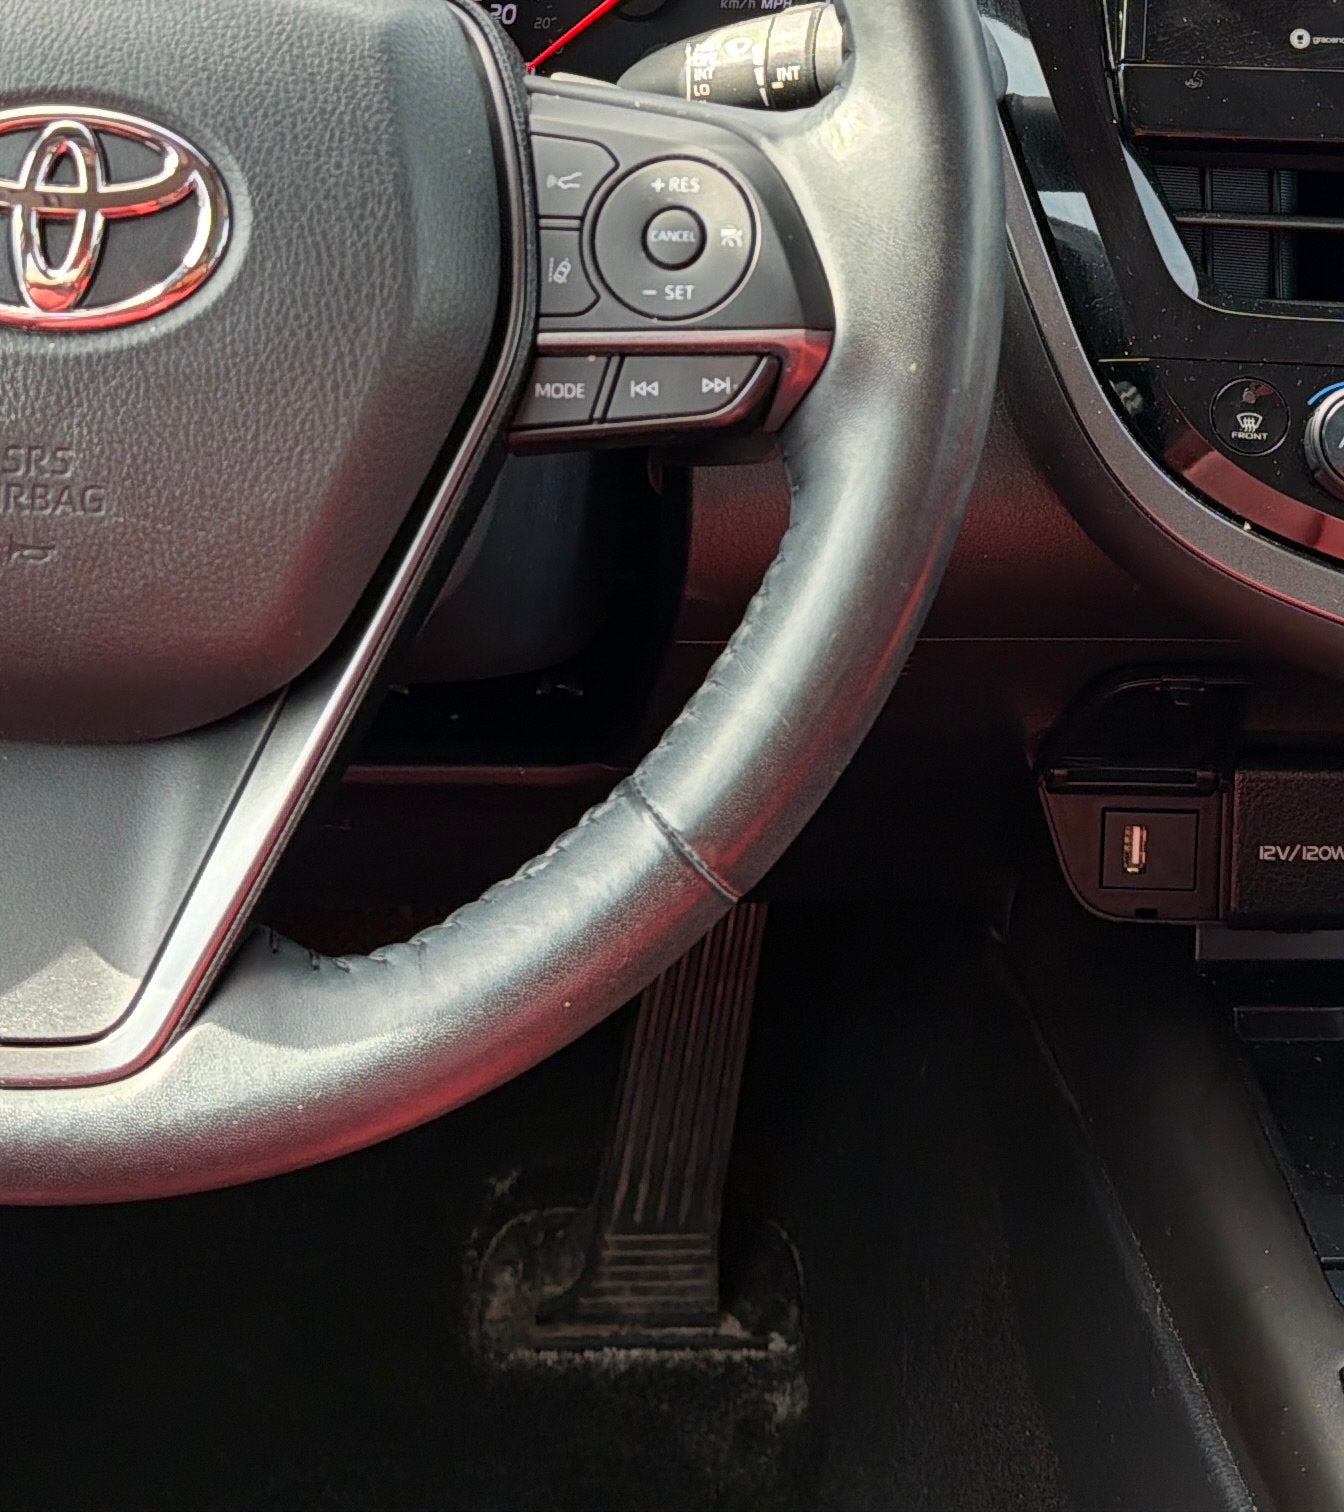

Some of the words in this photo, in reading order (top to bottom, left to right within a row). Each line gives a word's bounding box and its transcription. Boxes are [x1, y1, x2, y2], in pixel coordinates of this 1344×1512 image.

[490, 3, 517, 25] 20
[533, 16, 552, 30] 20
[776, 65, 801, 82] INT
[693, 84, 711, 97] LO
[651, 230, 696, 242] CANCEL
[534, 382, 586, 400] MODE
[1231, 430, 1269, 441] FRONT
[1, 444, 76, 478] SRS
